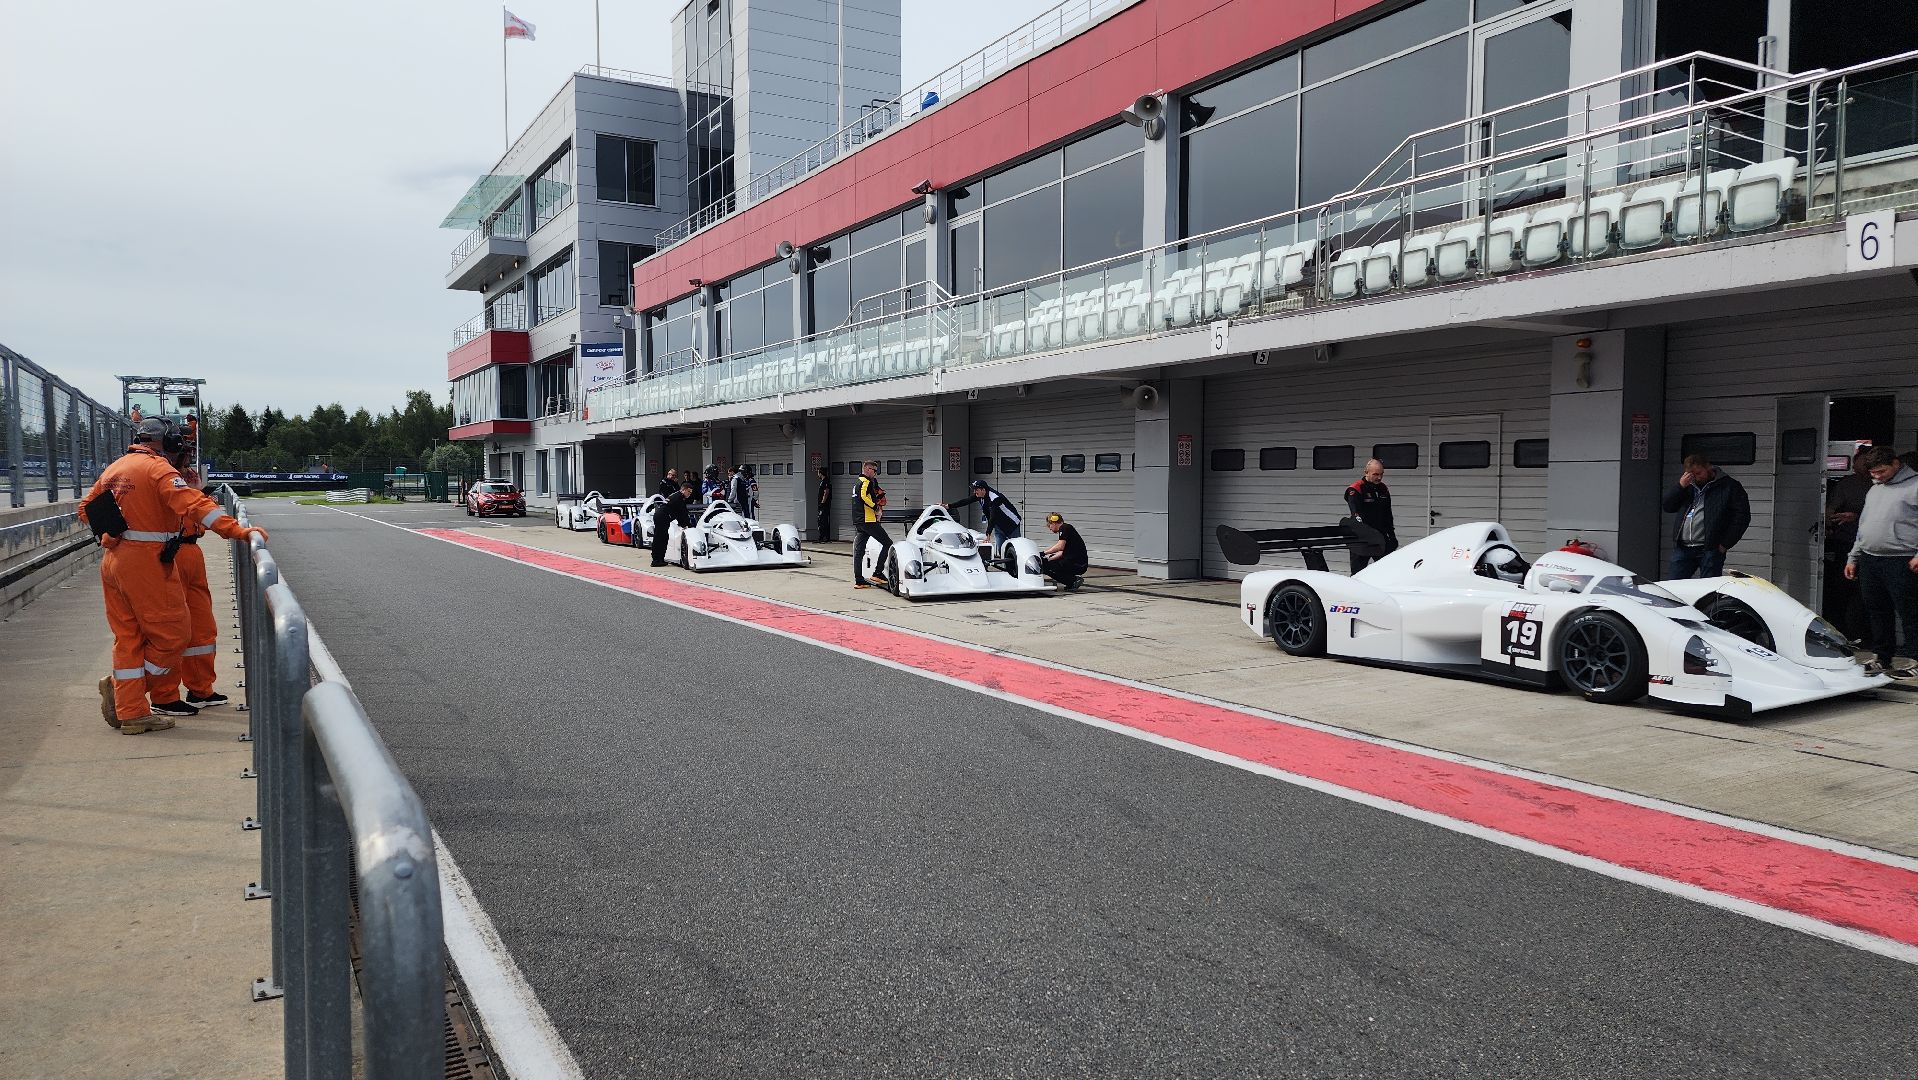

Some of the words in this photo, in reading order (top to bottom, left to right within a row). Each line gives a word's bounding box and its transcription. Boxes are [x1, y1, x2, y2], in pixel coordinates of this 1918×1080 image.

[1861, 222, 1879, 260] 6
[1215, 326, 1223, 350] 5
[1260, 351, 1267, 363] 5
[934, 372, 940, 388] 4
[970, 389, 976, 399] 4
[1506, 620, 1537, 646] 19
